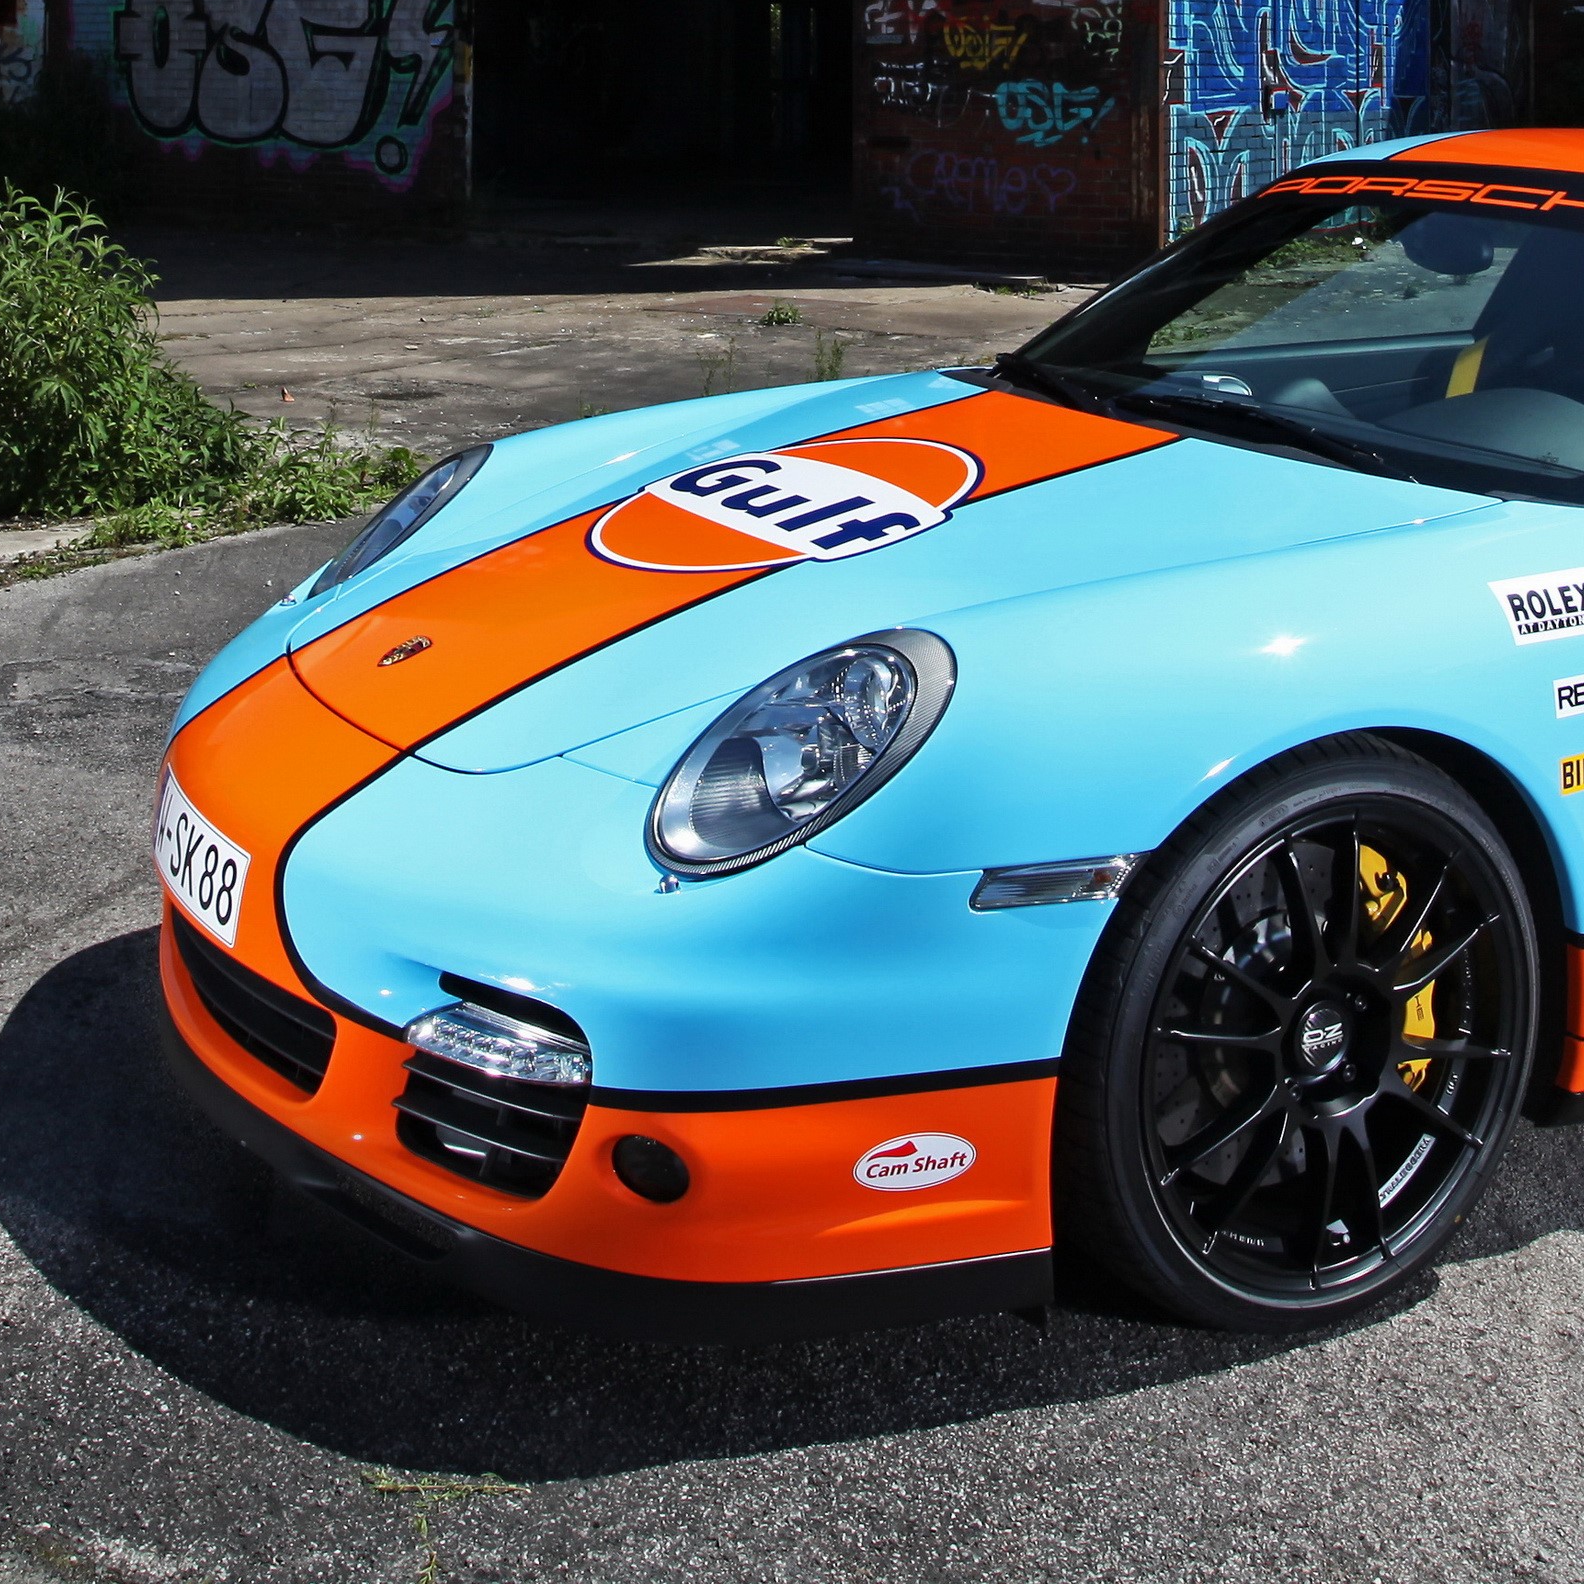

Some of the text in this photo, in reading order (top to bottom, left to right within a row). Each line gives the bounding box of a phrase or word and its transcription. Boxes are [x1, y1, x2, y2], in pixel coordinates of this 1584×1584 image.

[670, 459, 921, 550] Gulf
[1520, 623, 1535, 635] AT
[866, 1152, 967, 1179] Cam Shaft
